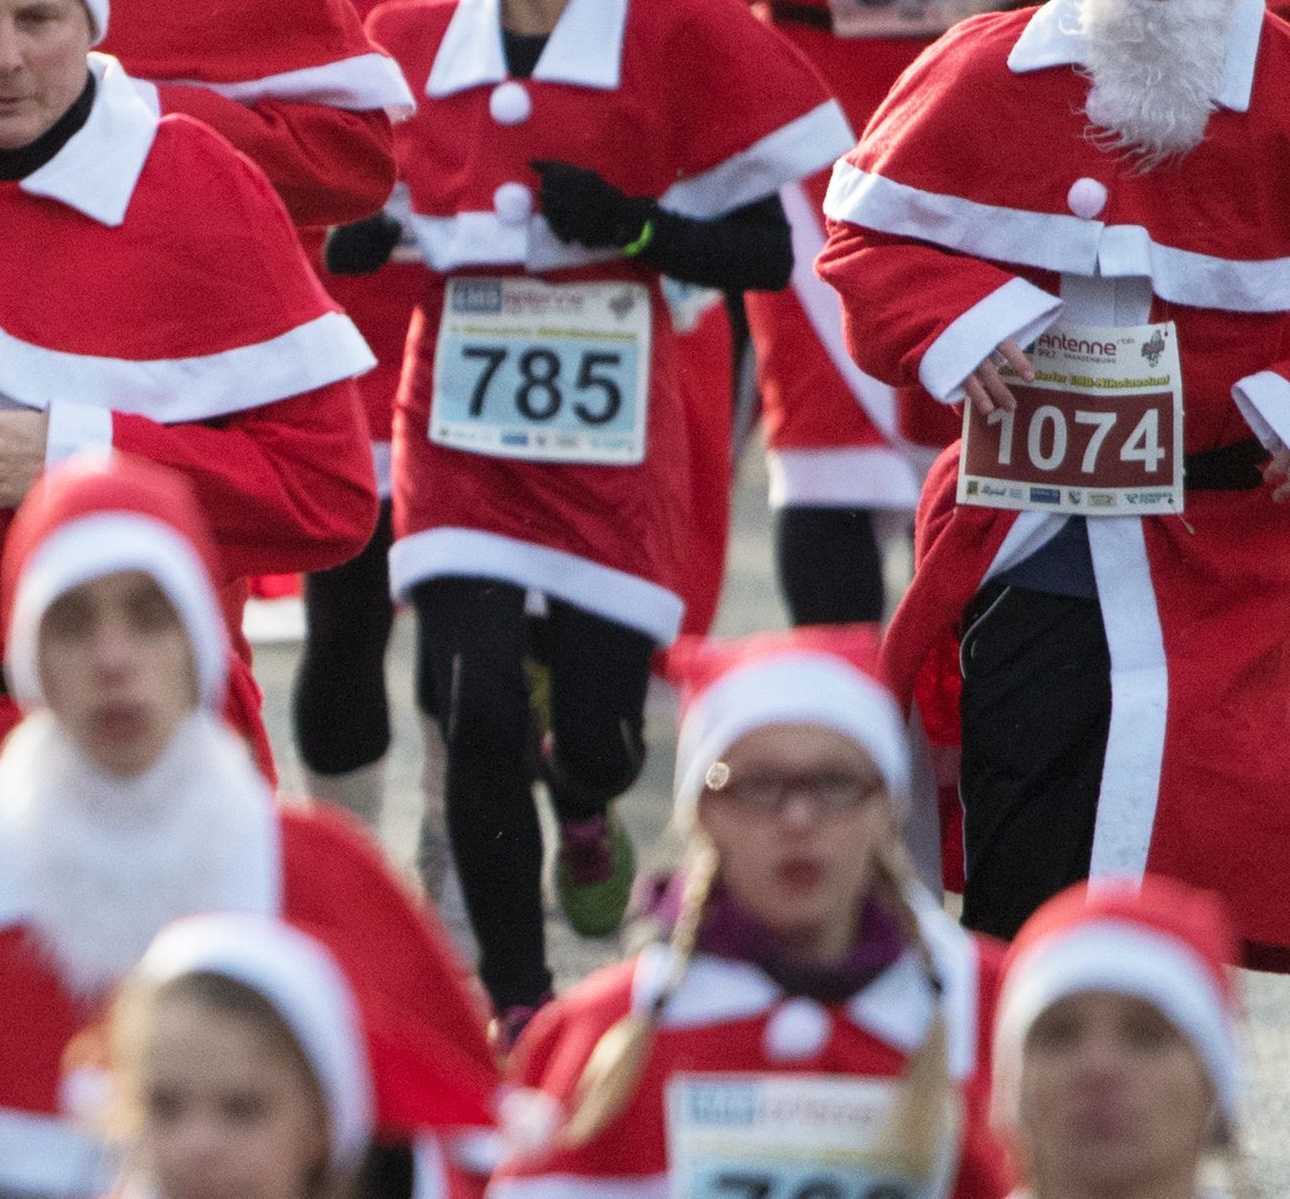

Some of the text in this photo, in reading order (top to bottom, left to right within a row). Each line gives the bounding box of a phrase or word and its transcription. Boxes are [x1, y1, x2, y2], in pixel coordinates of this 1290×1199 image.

[1037, 333, 1117, 356] Antenne
[461, 345, 622, 426] 785
[986, 404, 1166, 474] 1074
